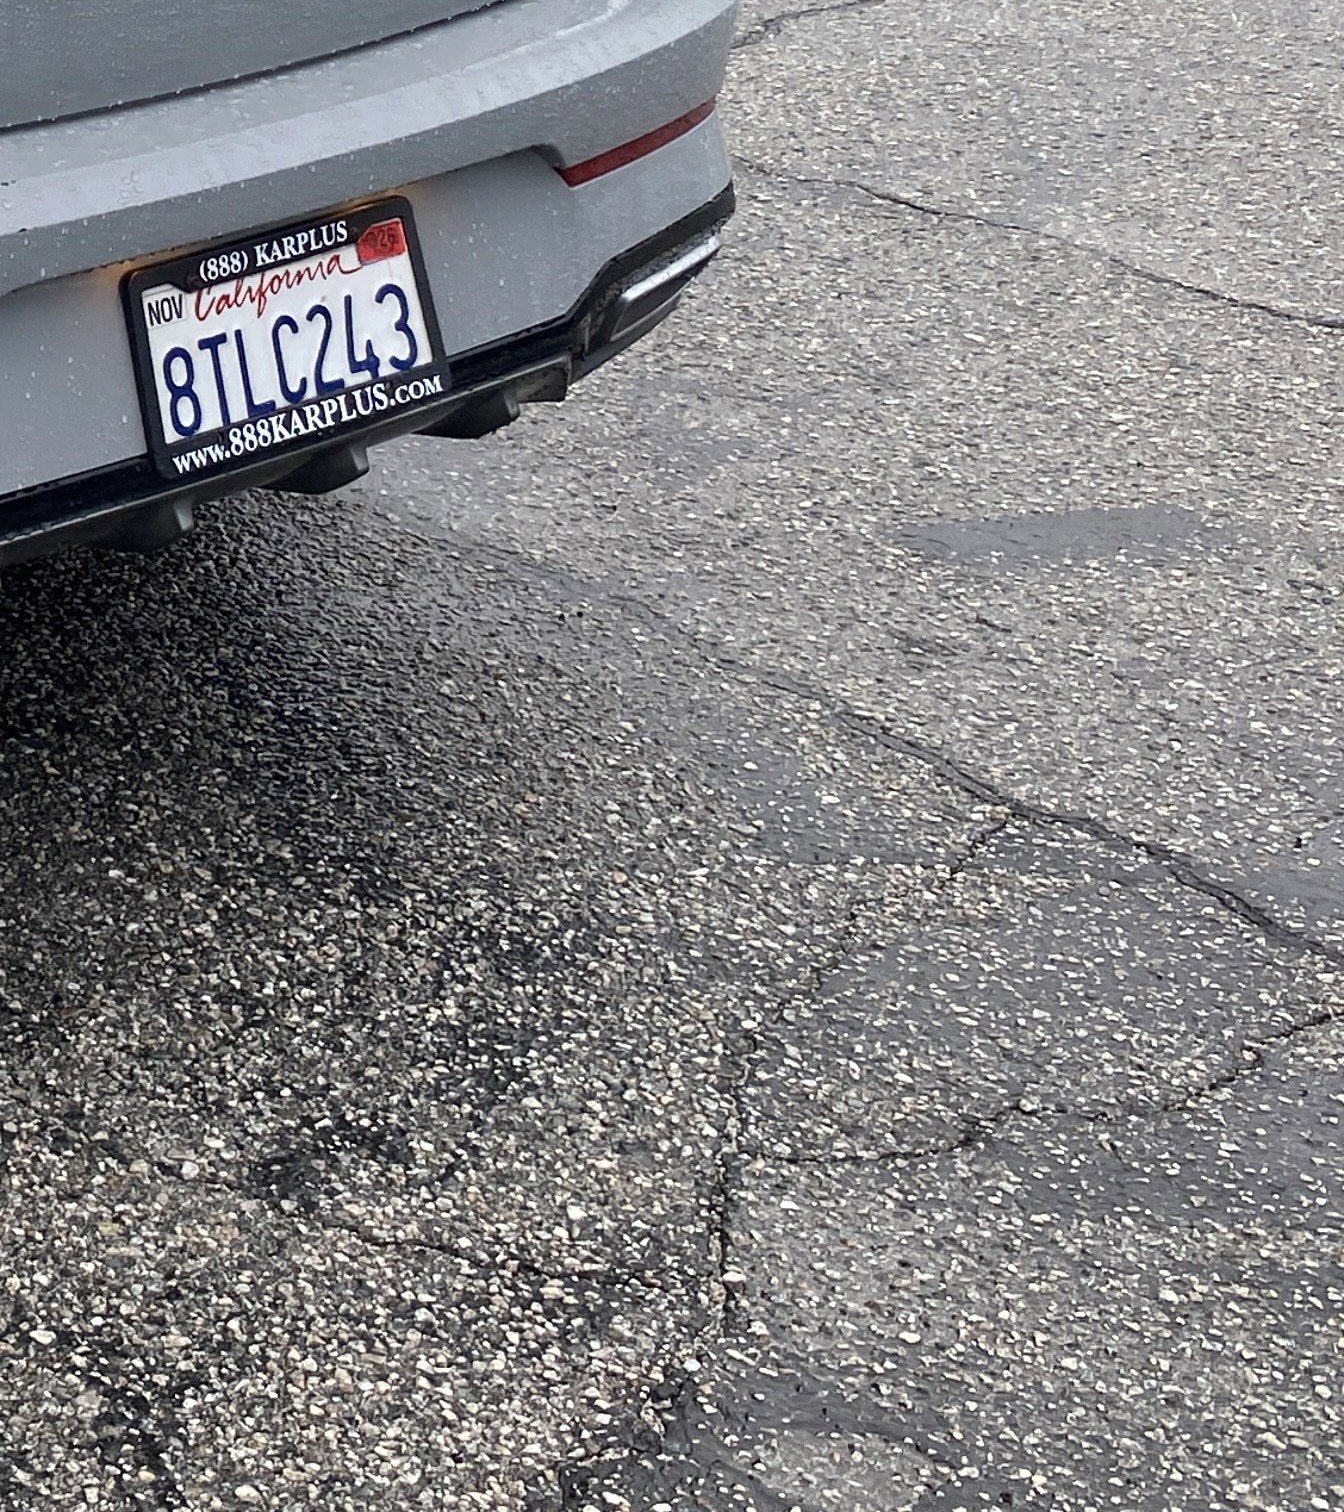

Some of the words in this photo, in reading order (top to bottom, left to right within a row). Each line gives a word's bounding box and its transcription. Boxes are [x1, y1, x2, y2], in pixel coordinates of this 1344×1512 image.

[199, 250, 249, 282] (888)
[255, 220, 349, 267] KARPLUS
[147, 293, 183, 326] NOV
[194, 254, 362, 322] California
[163, 283, 418, 437] 8TLC243
